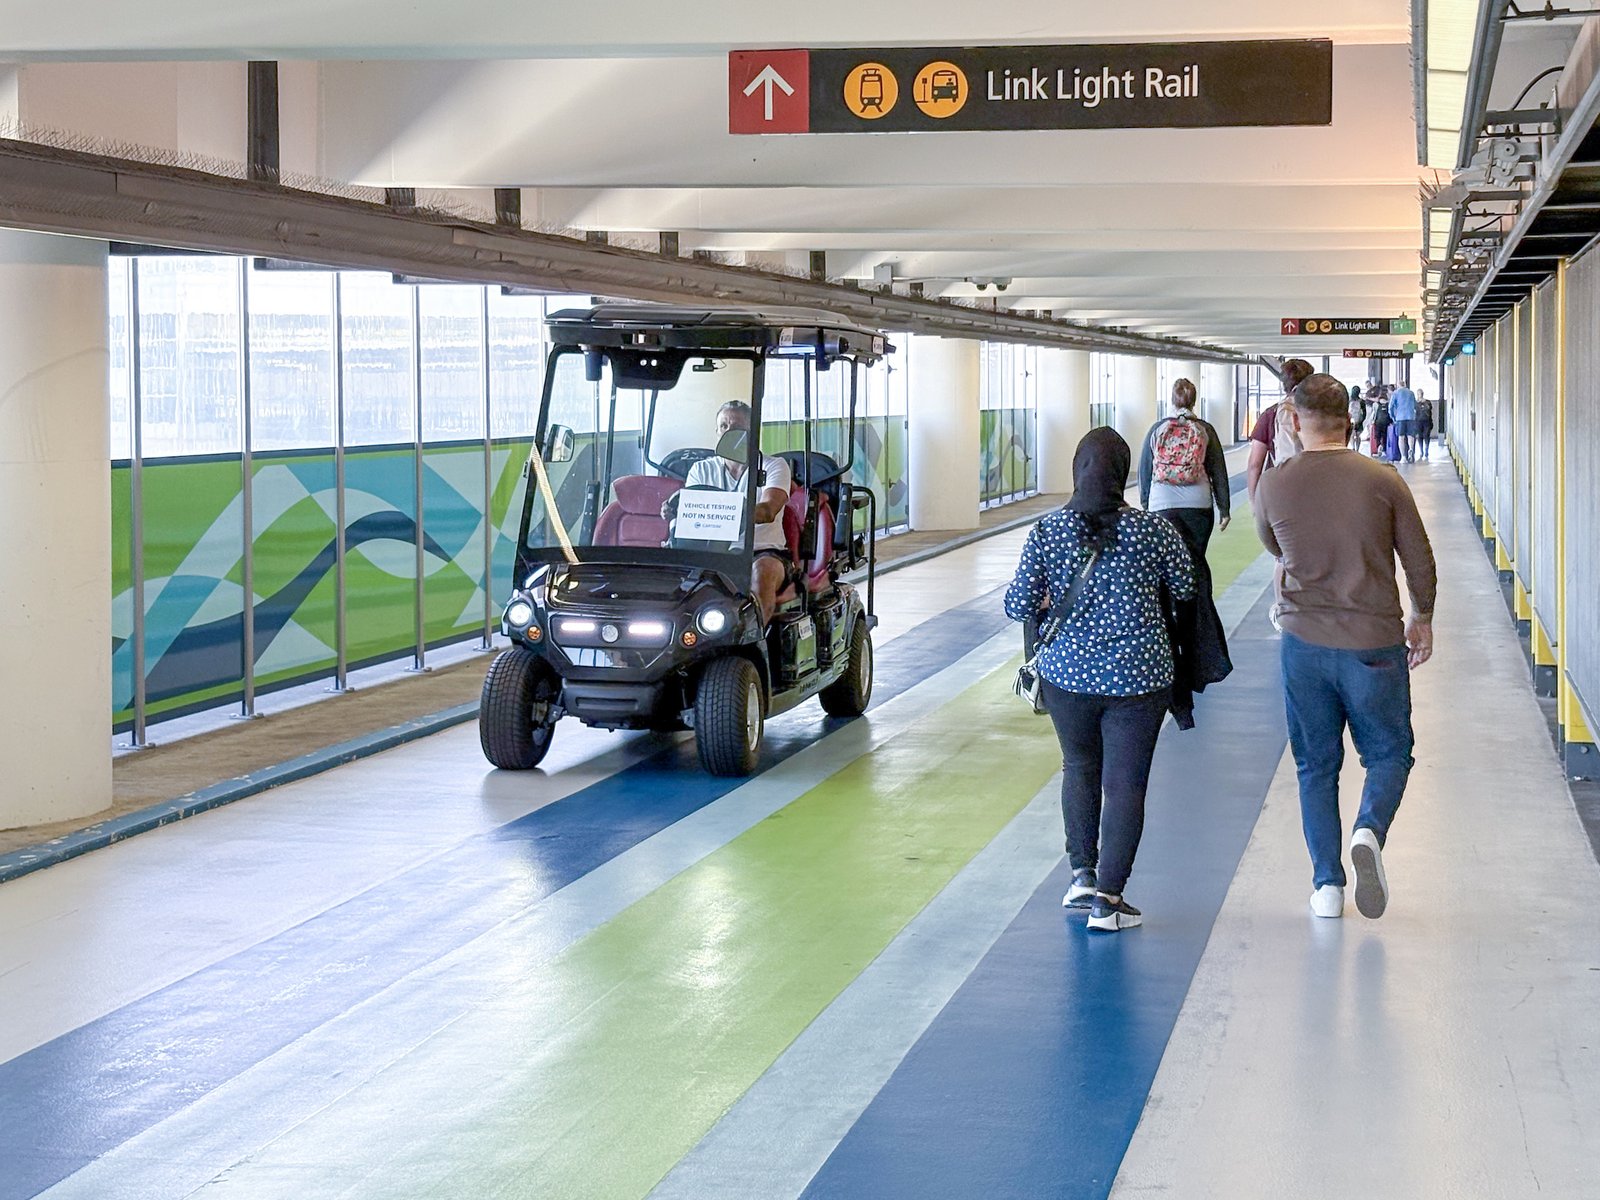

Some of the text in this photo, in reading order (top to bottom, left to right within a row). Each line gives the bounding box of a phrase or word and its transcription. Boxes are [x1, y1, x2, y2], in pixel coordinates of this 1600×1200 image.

[987, 64, 1199, 108] Link Light Rail
[1334, 321, 1380, 332] Link Light Rail
